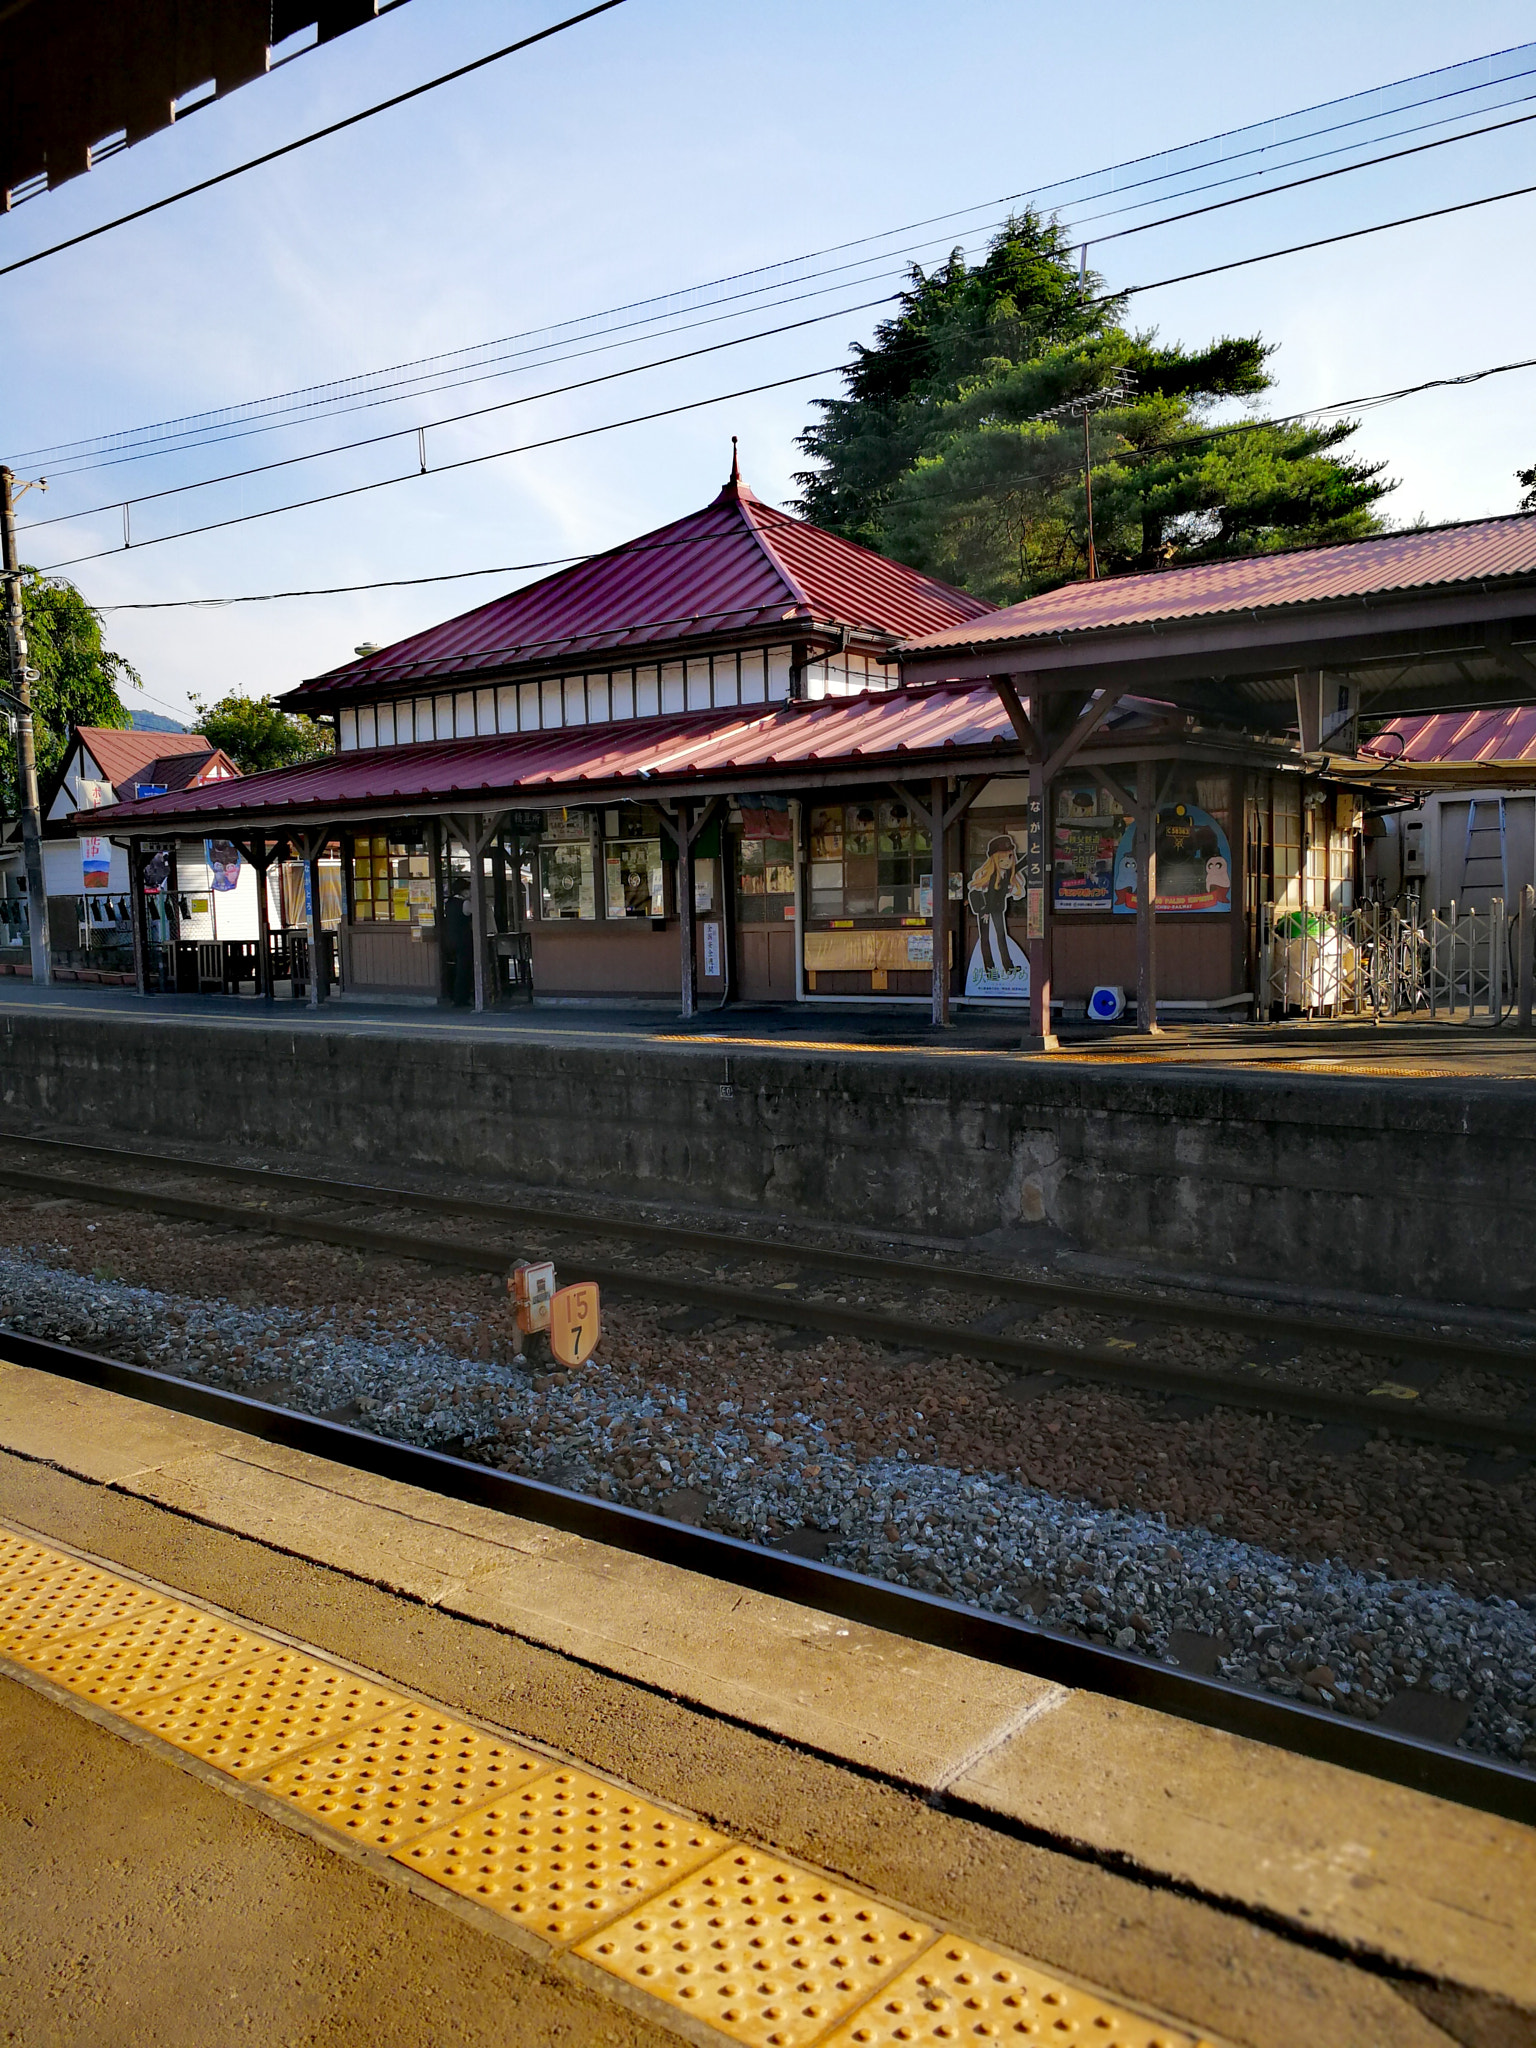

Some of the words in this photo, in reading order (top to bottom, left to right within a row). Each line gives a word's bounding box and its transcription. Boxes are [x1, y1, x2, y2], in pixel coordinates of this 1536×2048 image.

[1030, 801, 1041, 875] ながとろ
[972, 966, 1029, 986] 鉄道むすめ
[566, 1290, 588, 1323] 15
[571, 1325, 582, 1356] 7
